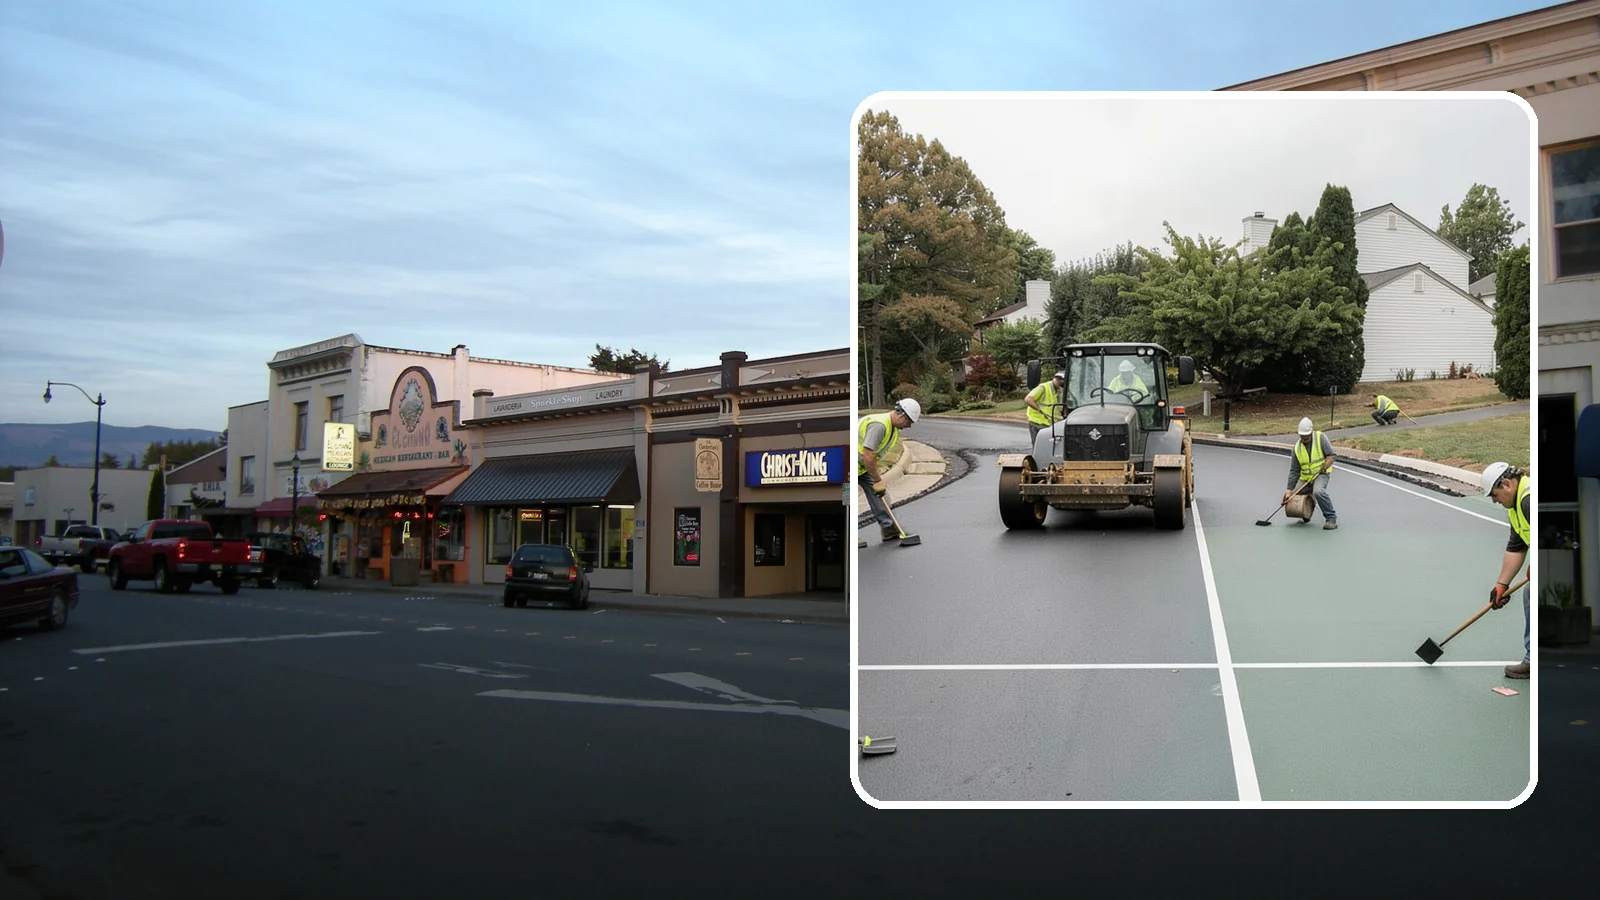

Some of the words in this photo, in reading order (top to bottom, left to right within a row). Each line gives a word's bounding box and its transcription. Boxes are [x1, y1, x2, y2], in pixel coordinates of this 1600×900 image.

[493, 402, 523, 413] LAVANDERIA
[531, 397, 561, 409] Sparkle
[561, 394, 583, 405] Shop
[595, 389, 624, 400] LAUNDRY
[398, 451, 434, 462] RESTAURANT
[438, 450, 450, 459] BAR
[760, 452, 797, 478] CHRIST
[799, 450, 828, 476] KING
